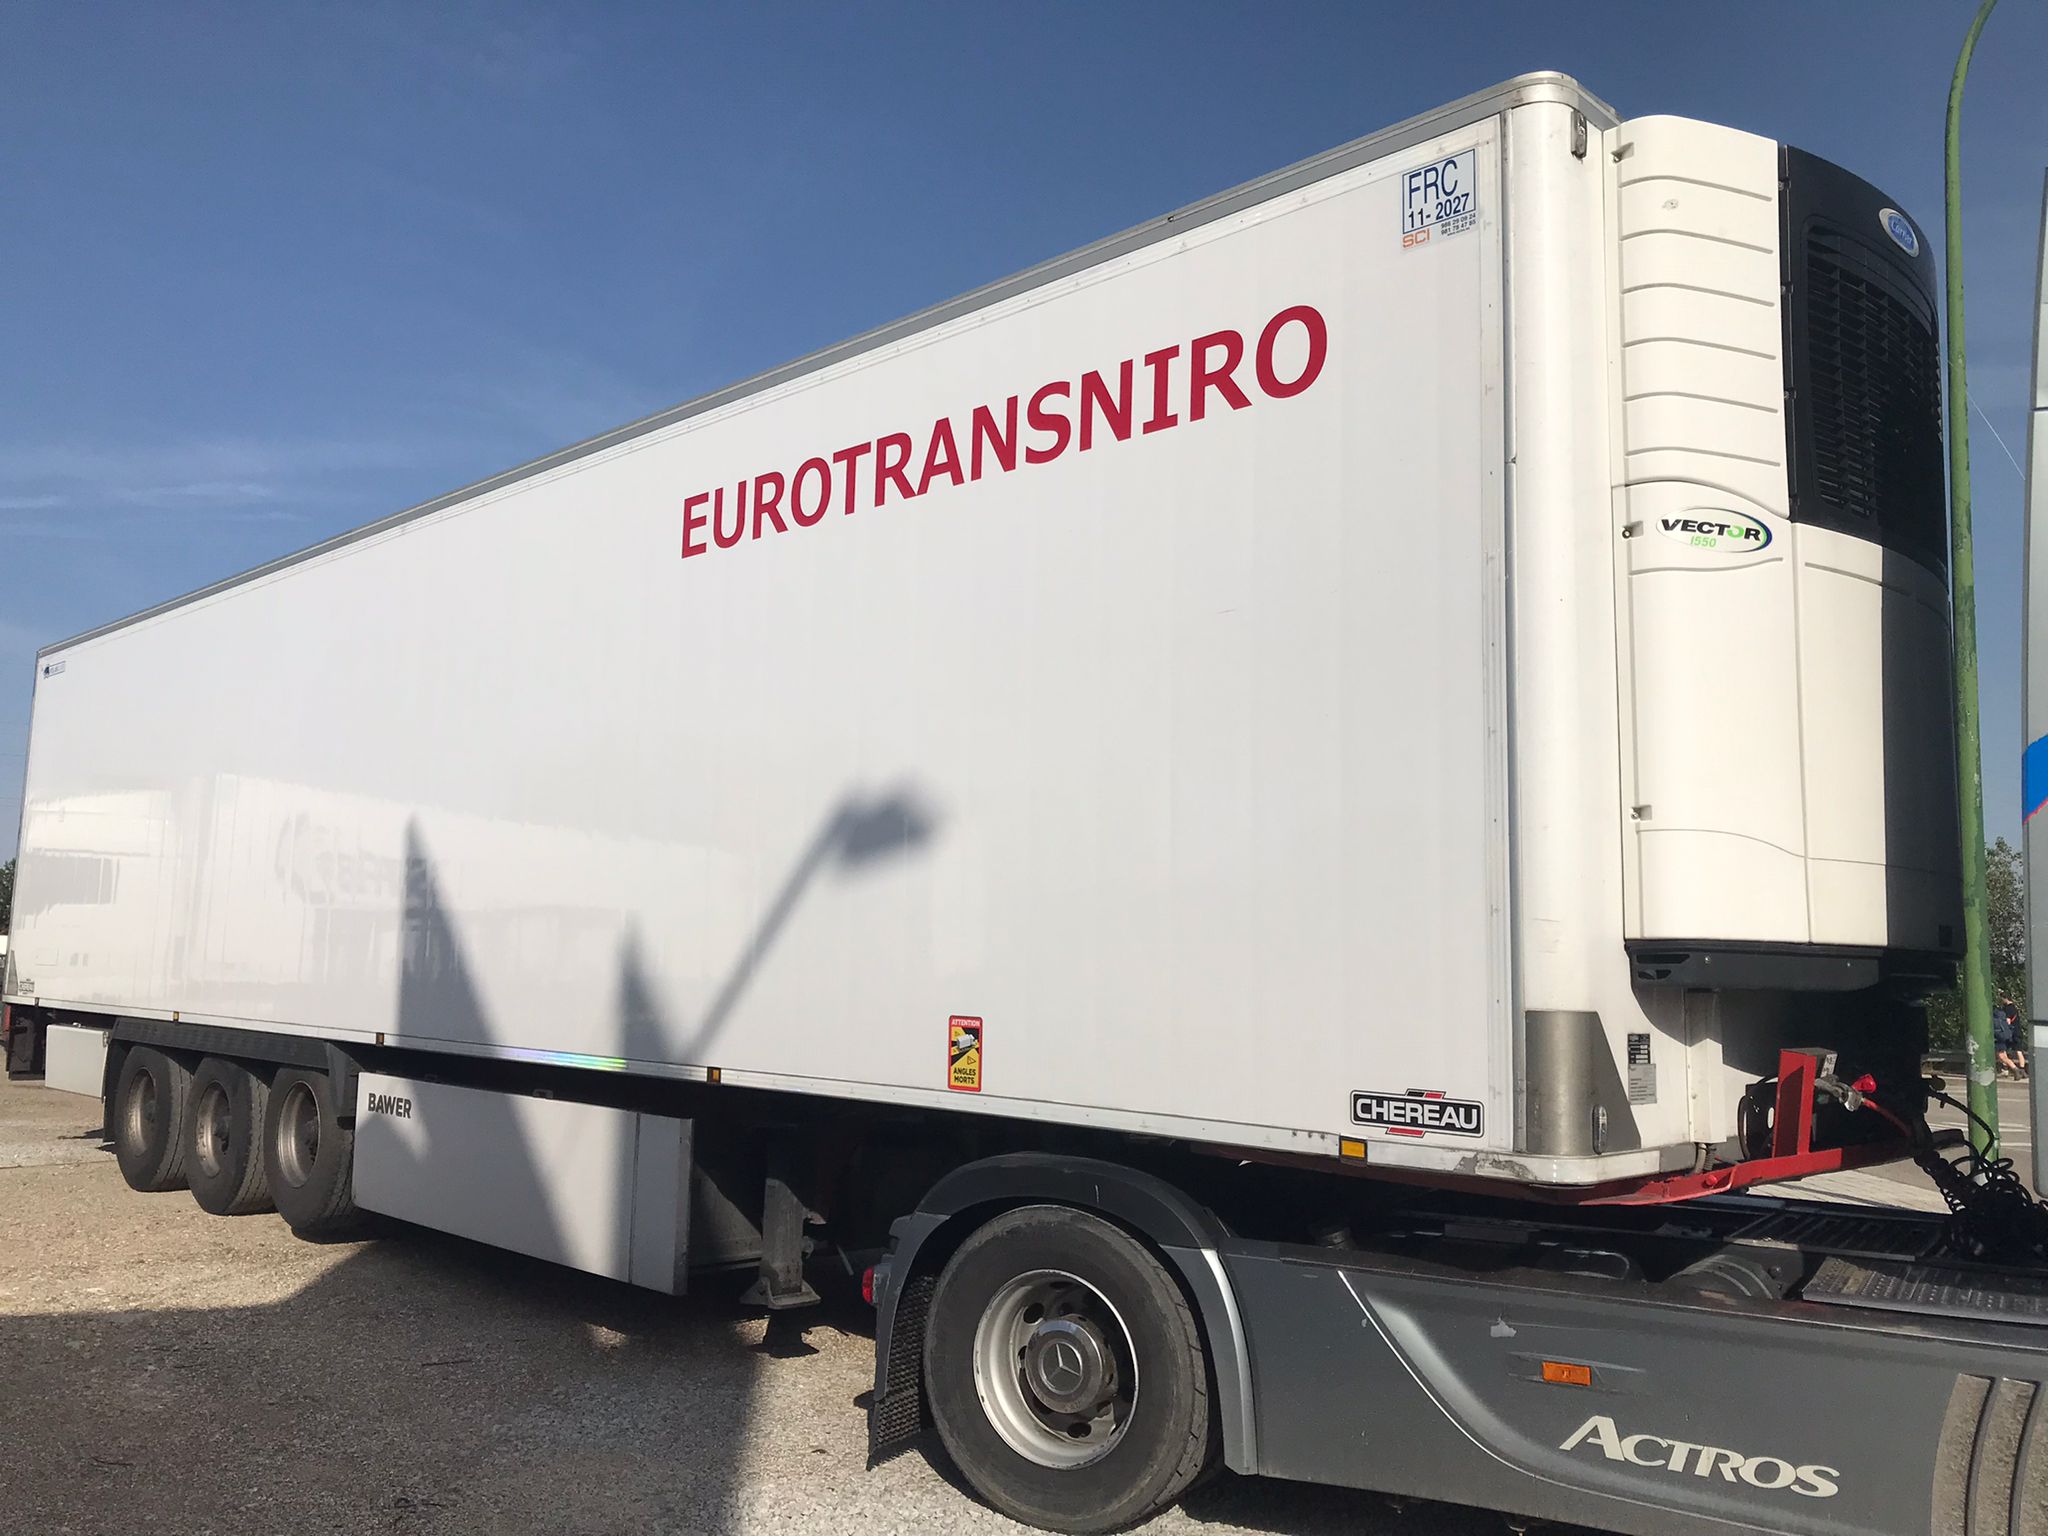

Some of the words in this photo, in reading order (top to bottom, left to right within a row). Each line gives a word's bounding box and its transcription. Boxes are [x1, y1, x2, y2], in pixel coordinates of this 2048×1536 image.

[1408, 159, 1458, 209] FRC
[1435, 192, 1470, 221] 2027
[1402, 228, 1430, 248] SCI
[681, 304, 1328, 558] EUROTRANSNIRO
[1661, 519, 1761, 542] VECTOR
[952, 1018, 981, 1027] ATTENTION
[953, 1067, 977, 1076] ANGLES
[954, 1075, 975, 1085] MORTS
[368, 1092, 412, 1119] BAWER
[1355, 1098, 1478, 1130] CHEREAU
